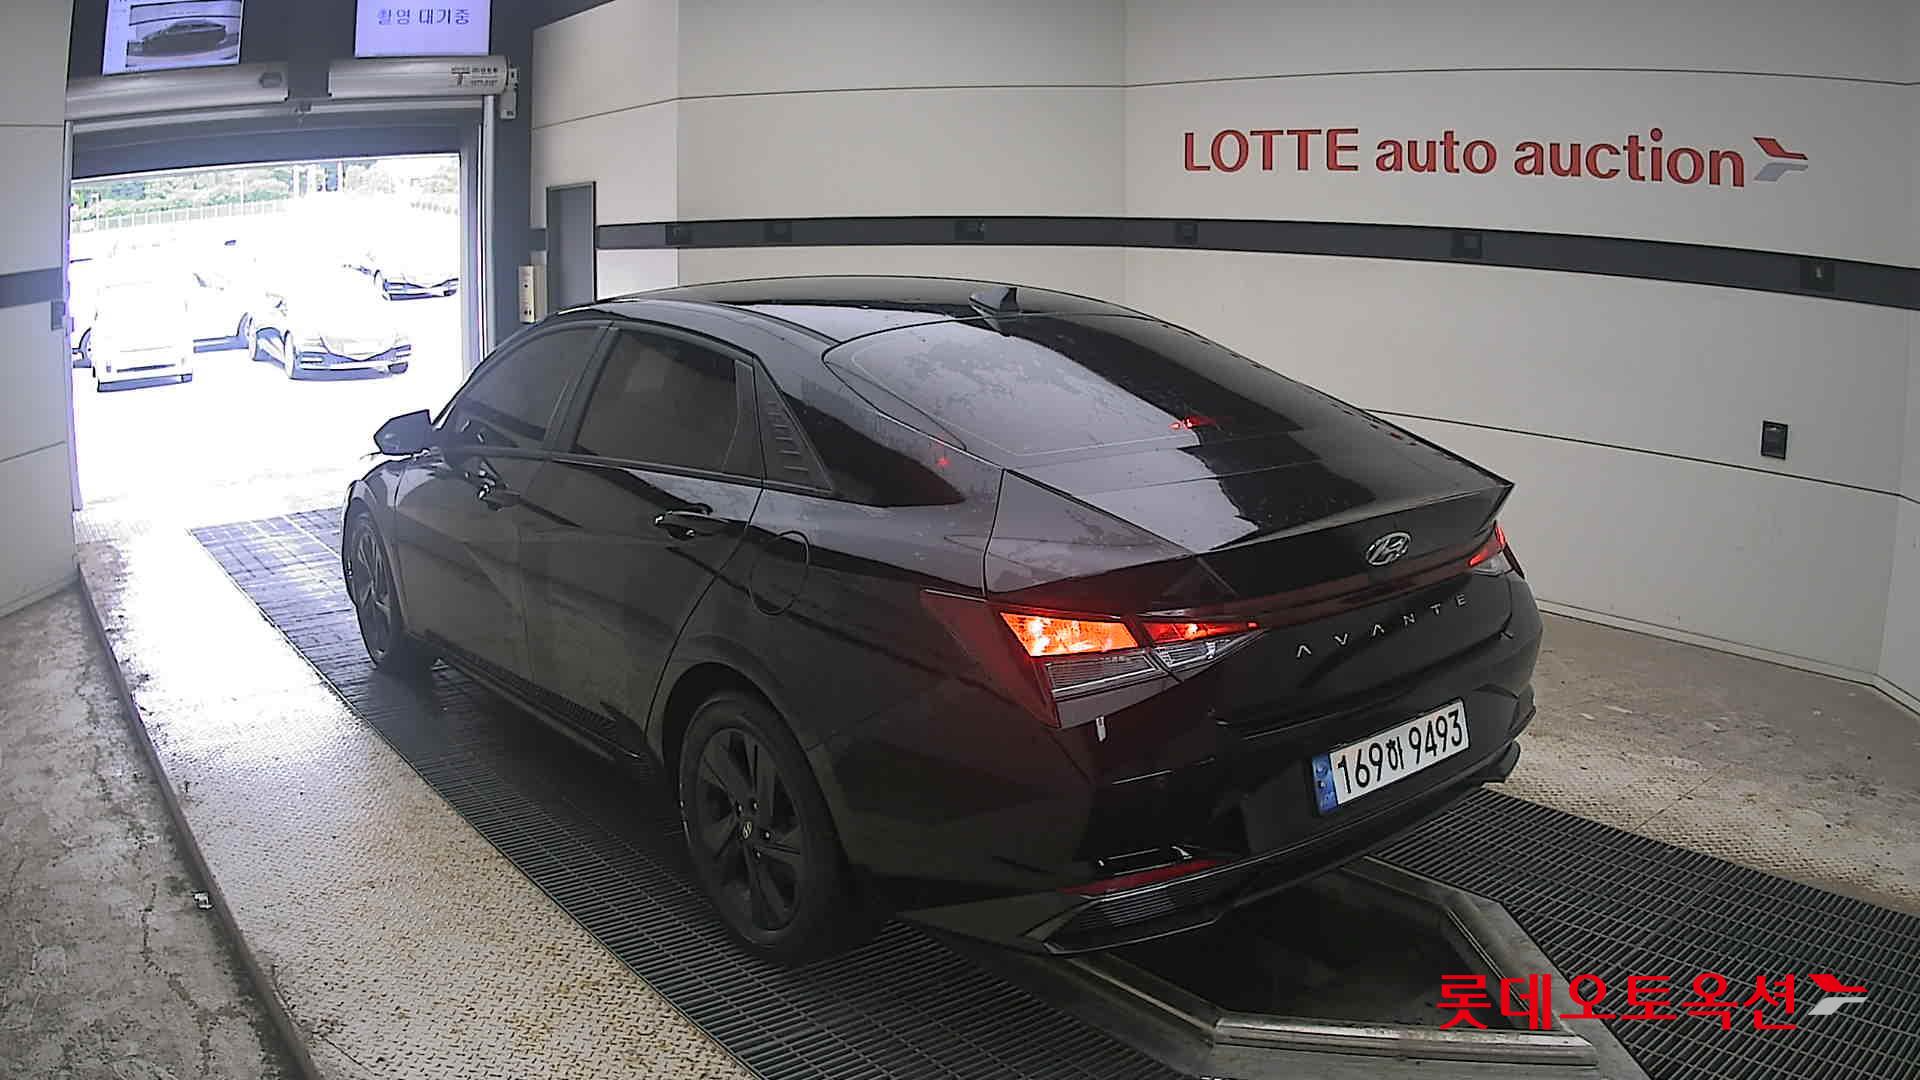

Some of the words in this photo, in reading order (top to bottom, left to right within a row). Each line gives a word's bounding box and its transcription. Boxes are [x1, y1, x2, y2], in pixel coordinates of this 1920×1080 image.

[418, 8, 471, 25] 대기중
[1184, 127, 1359, 172] LOTTE
[1375, 130, 1497, 174] auto
[1514, 127, 1746, 188] auction
[1296, 593, 1467, 659] AVANTE
[1337, 736, 1405, 794] 169하
[1408, 709, 1462, 765] 9493
